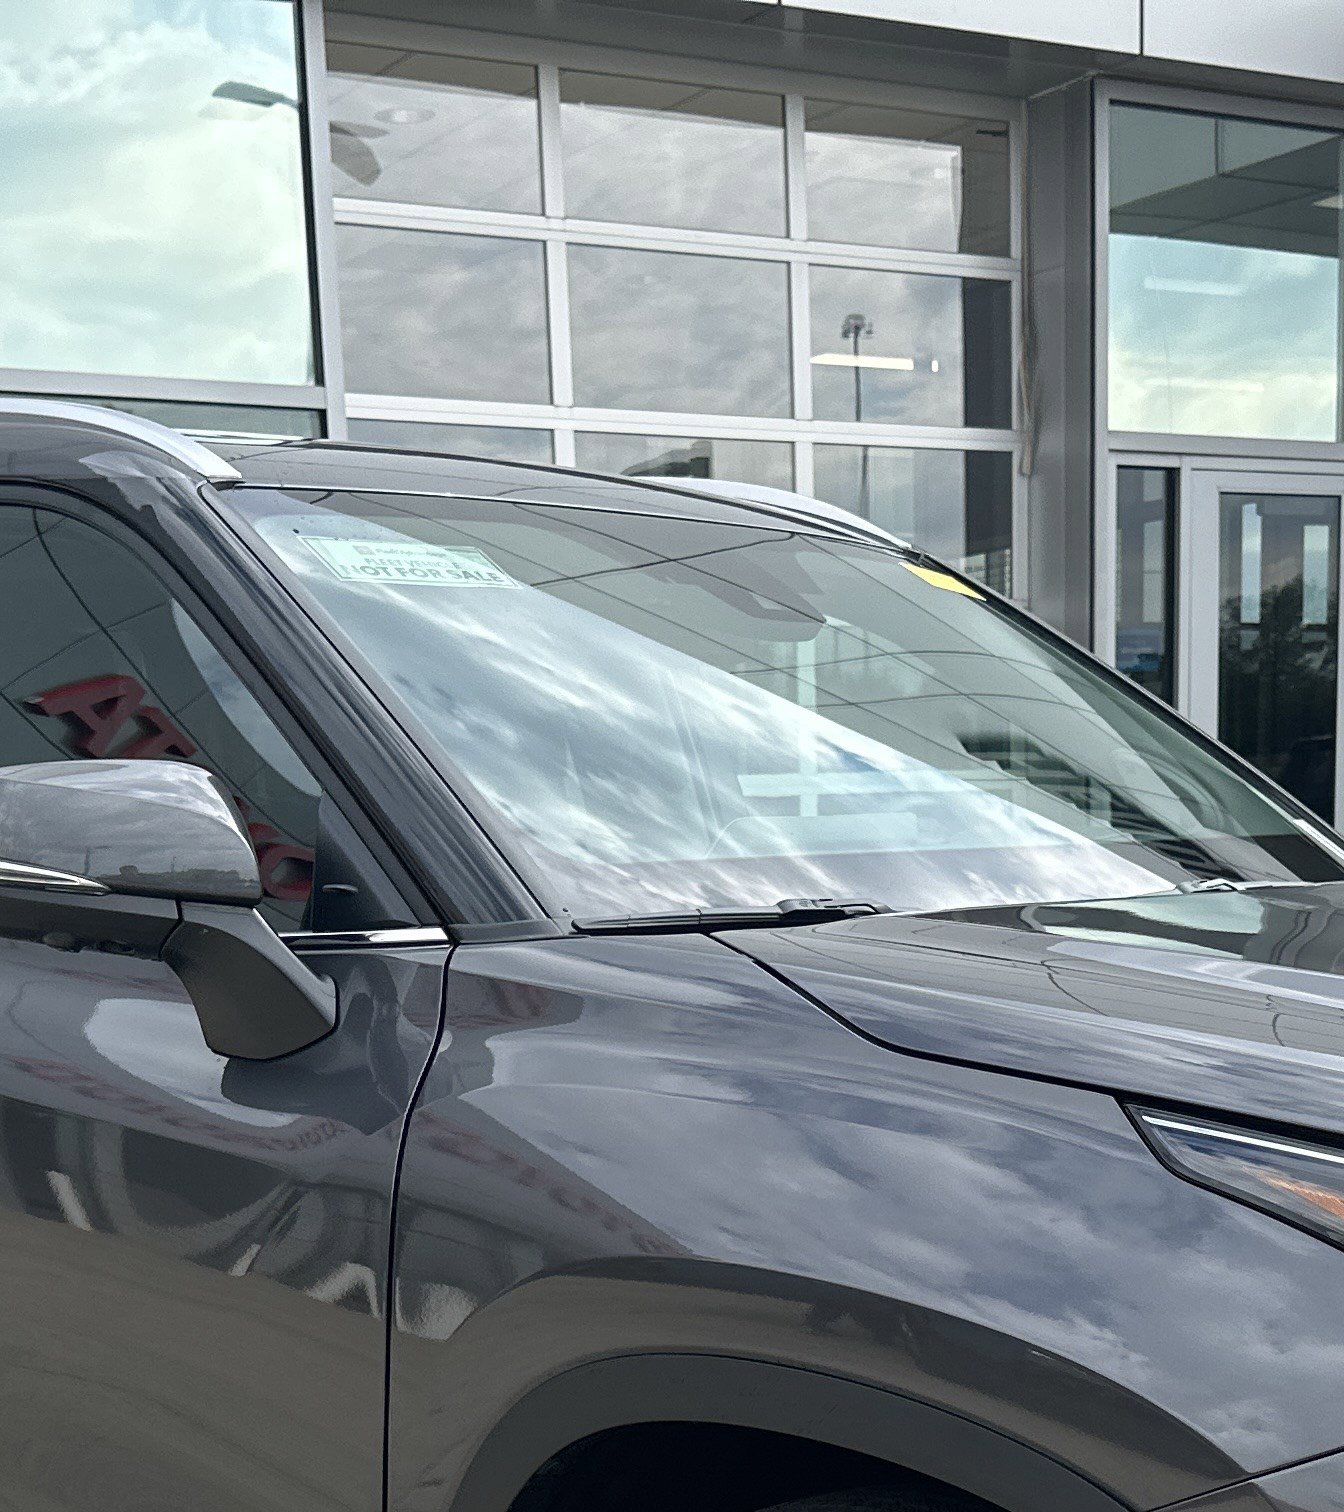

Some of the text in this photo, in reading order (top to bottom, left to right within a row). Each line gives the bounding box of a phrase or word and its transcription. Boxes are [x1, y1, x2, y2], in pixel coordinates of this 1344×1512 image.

[364, 558, 405, 567] FLEET
[338, 564, 506, 582] NOT FOR SALE
